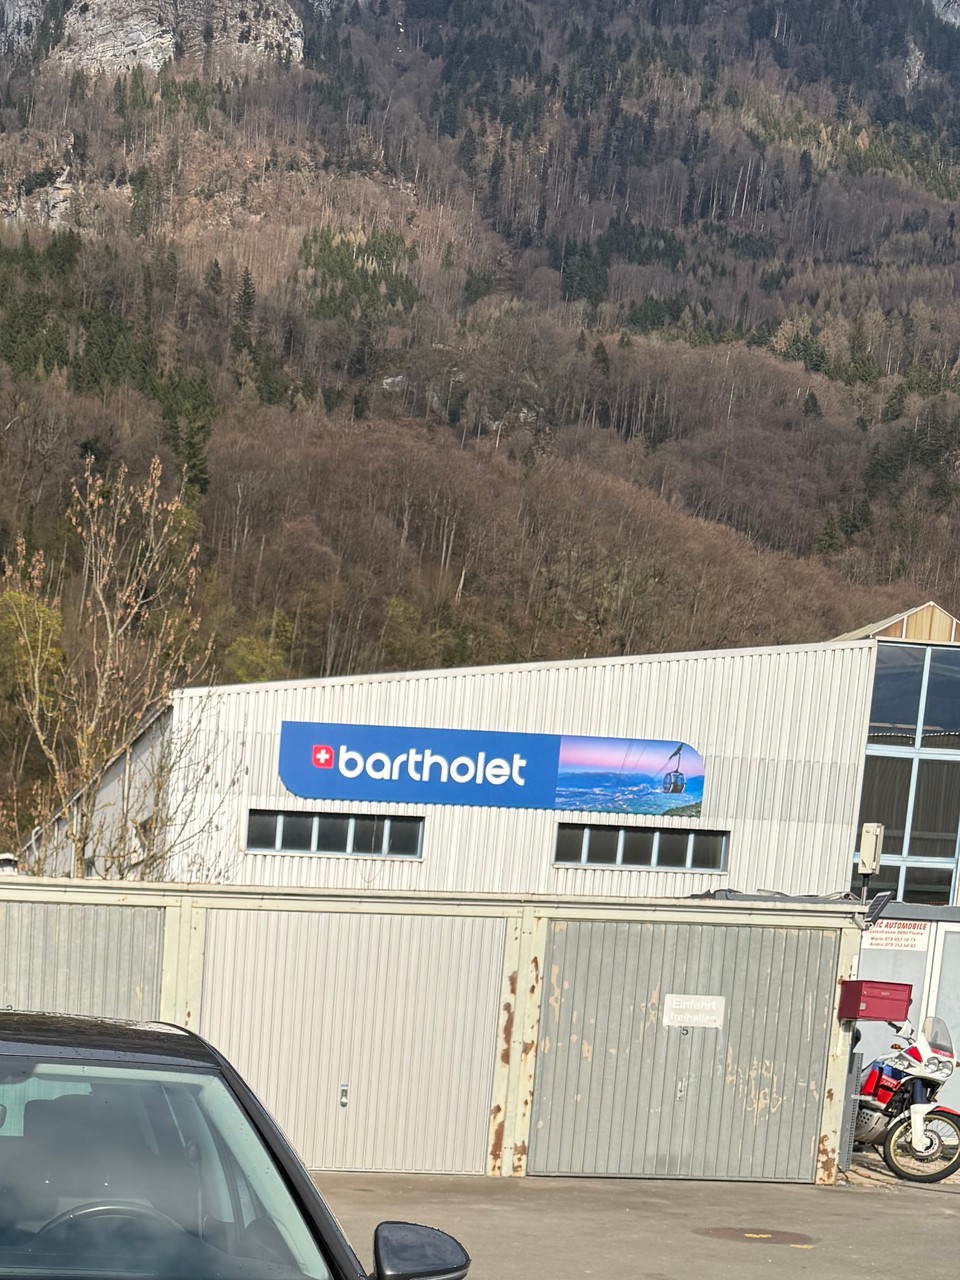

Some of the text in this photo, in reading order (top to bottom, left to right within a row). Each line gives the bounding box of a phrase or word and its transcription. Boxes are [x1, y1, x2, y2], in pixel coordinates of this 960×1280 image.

[338, 745, 527, 787] bartholet
[884, 921, 928, 931] AUTOMOBILE
[673, 998, 716, 1011] Einfahrt
[681, 1026, 689, 1036] 5
